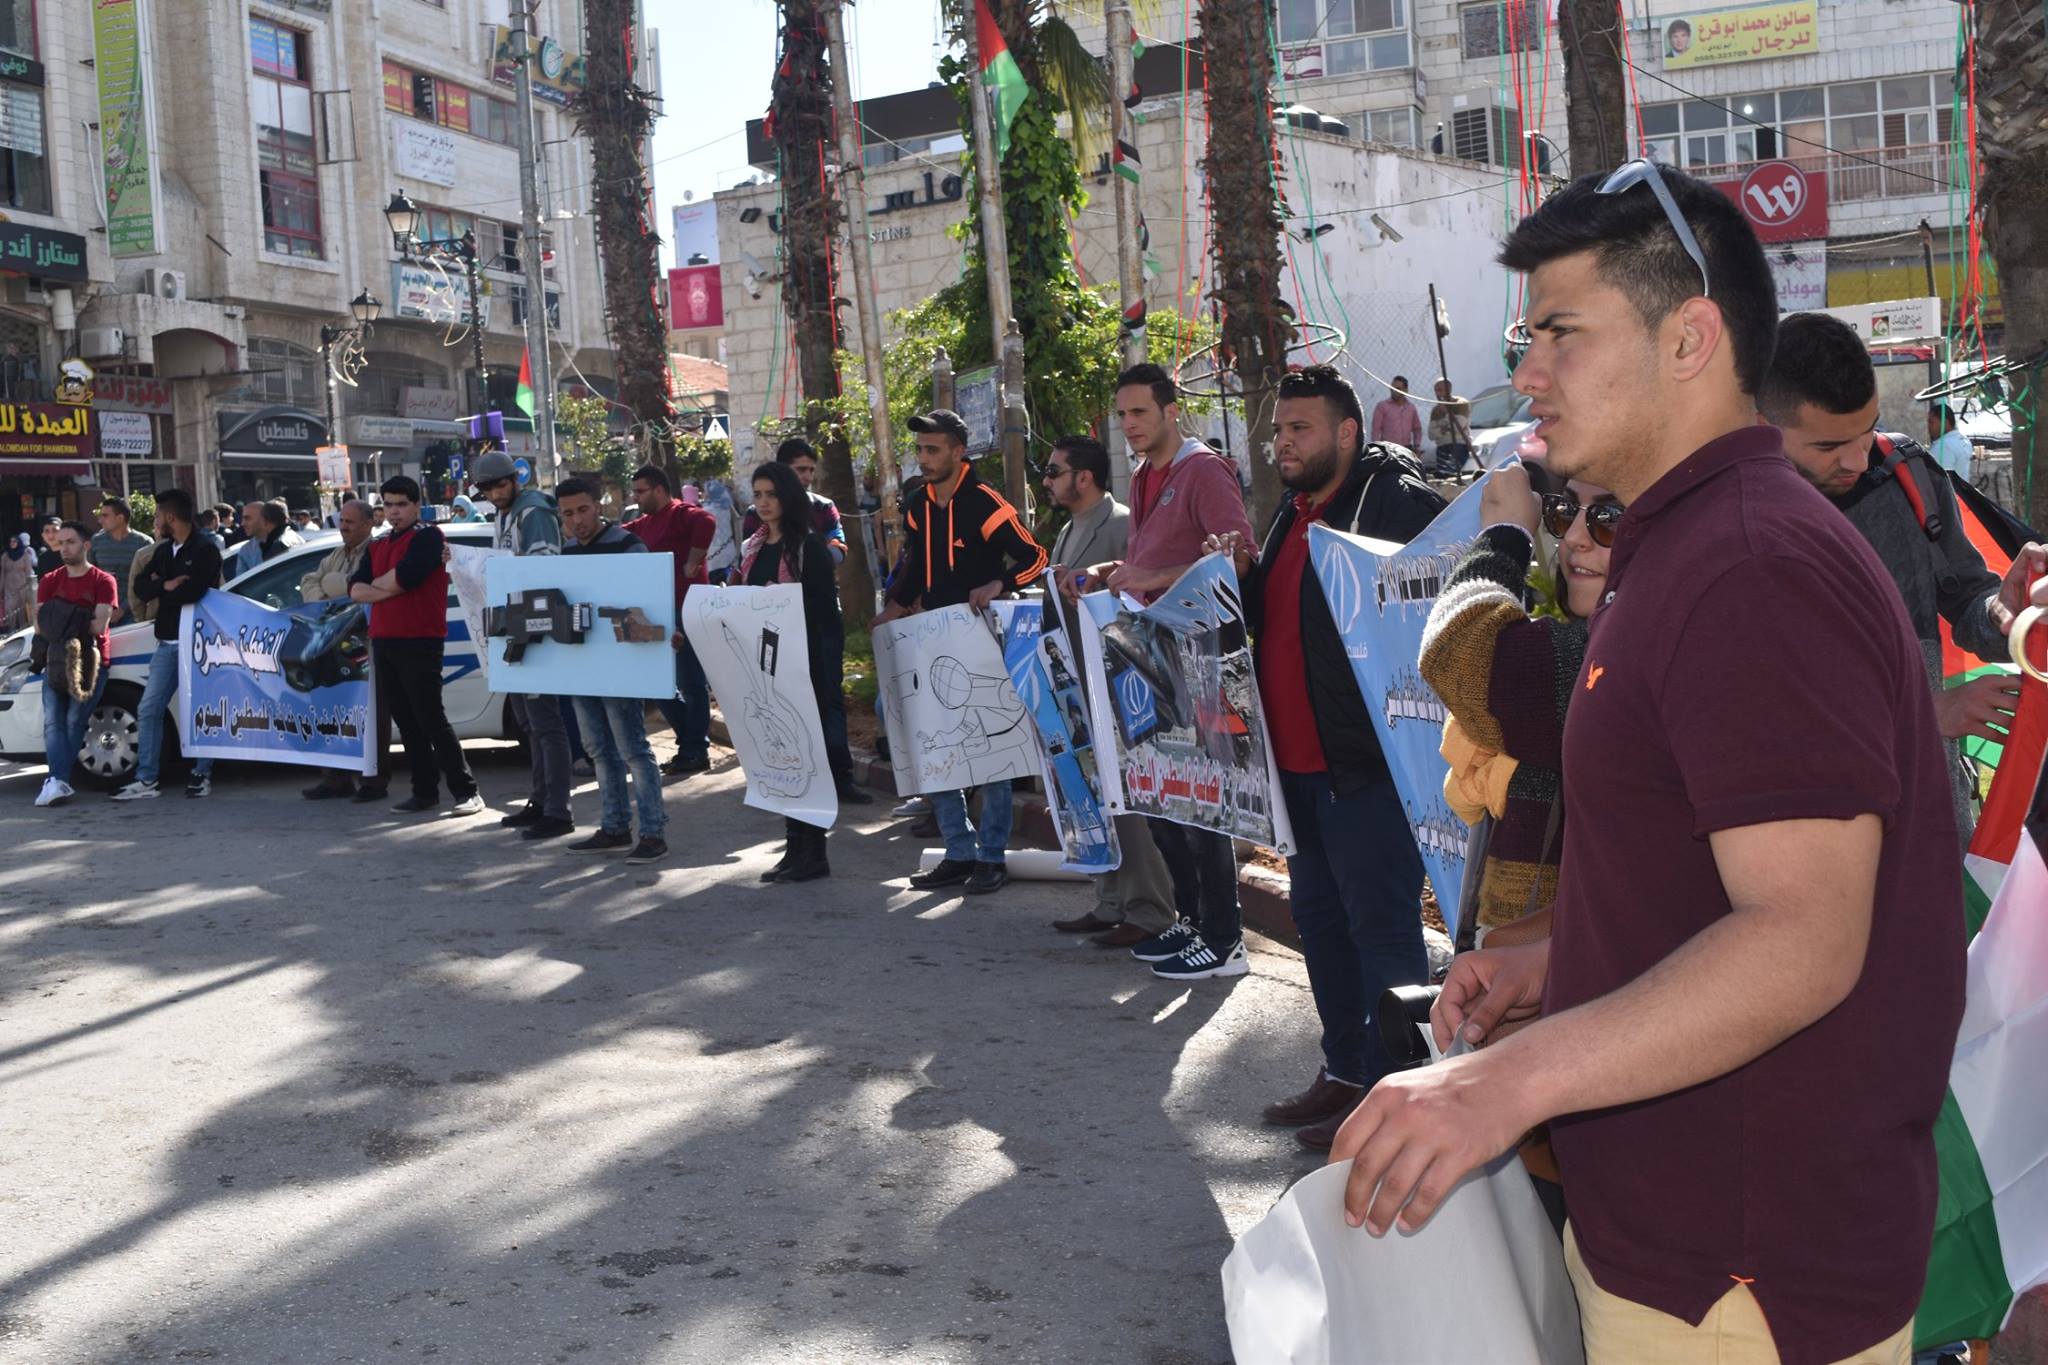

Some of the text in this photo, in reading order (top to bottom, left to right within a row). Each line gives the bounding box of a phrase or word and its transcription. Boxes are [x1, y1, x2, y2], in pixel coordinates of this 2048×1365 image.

[1742, 17, 1771, 32] محمد
[1774, 10, 1811, 32] صالون
[1751, 30, 1811, 54] للرجال
[20, 403, 88, 436] العمدة
[257, 420, 309, 443] فلسطين
[450, 459, 460, 477] P
[193, 696, 229, 741] اليوم
[229, 697, 273, 741] فلسطين
